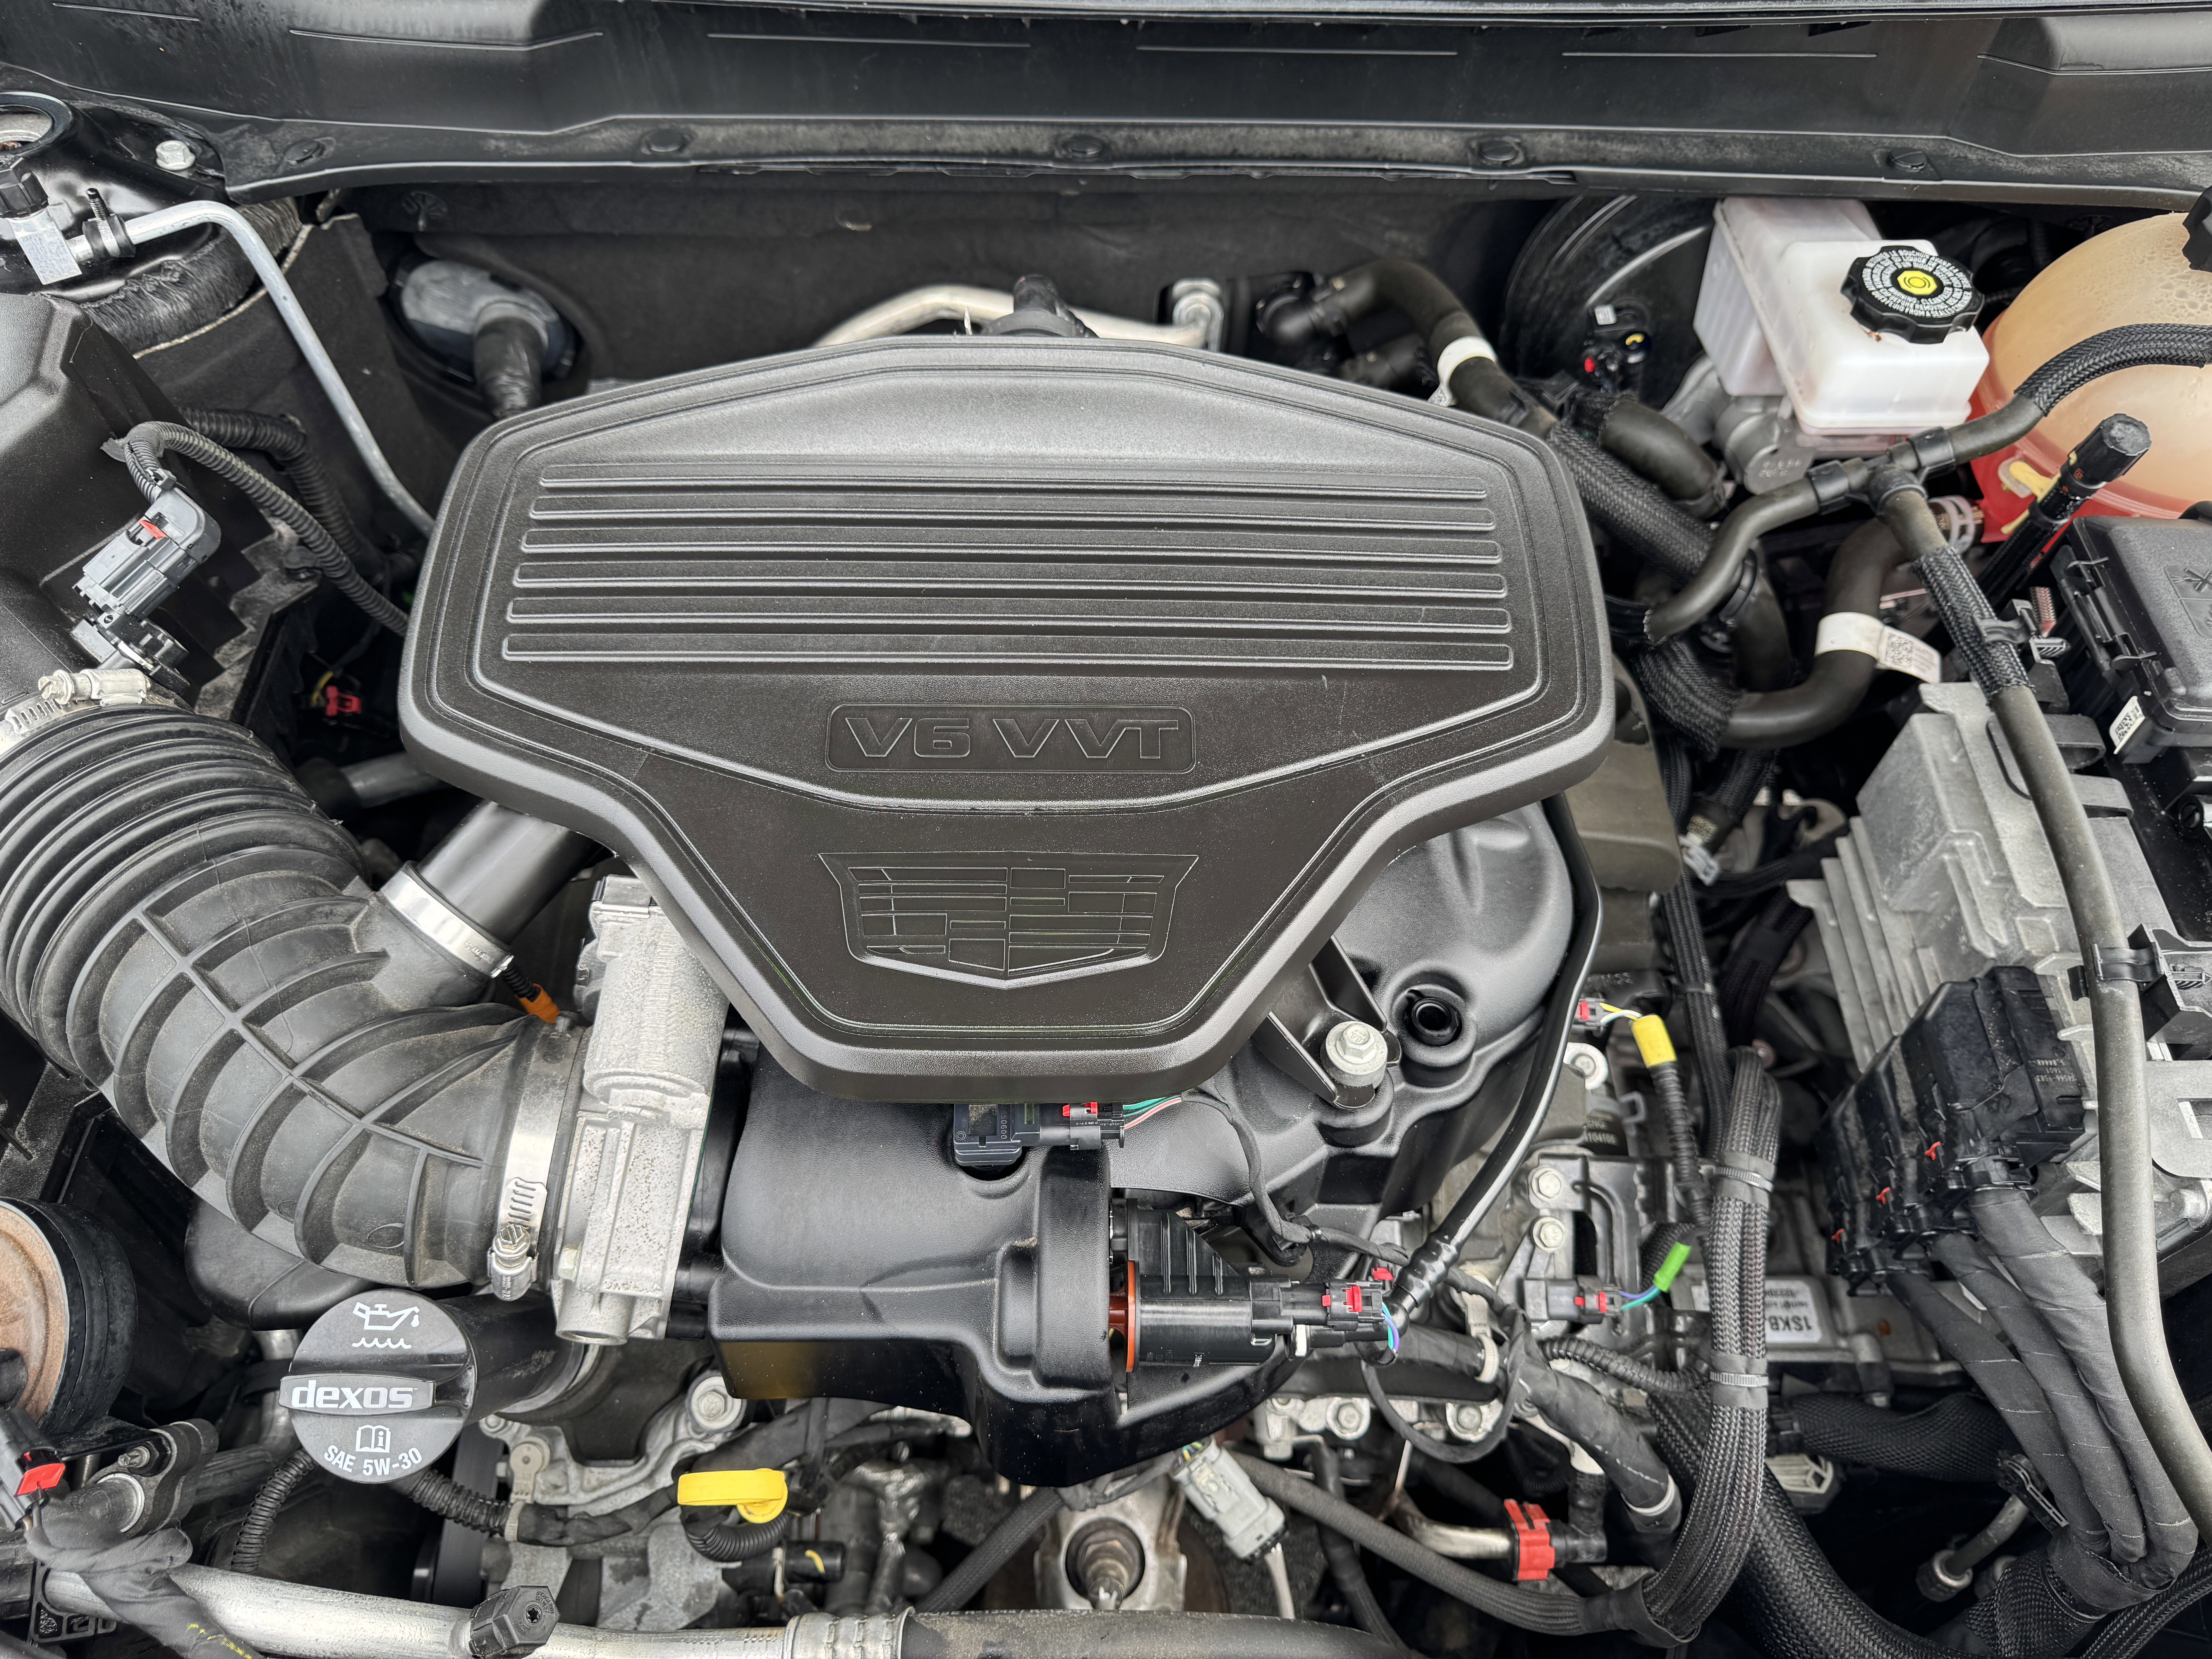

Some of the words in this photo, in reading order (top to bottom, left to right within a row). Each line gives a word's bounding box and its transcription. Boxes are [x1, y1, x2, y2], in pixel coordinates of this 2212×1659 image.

[845, 717, 970, 757] V6
[993, 718, 1178, 759] VVT
[1765, 1316, 1812, 1331] 1SKB
[291, 1379, 414, 1409] dexos
[324, 1444, 356, 1473] SAE
[362, 1447, 422, 1476] 5W-30
